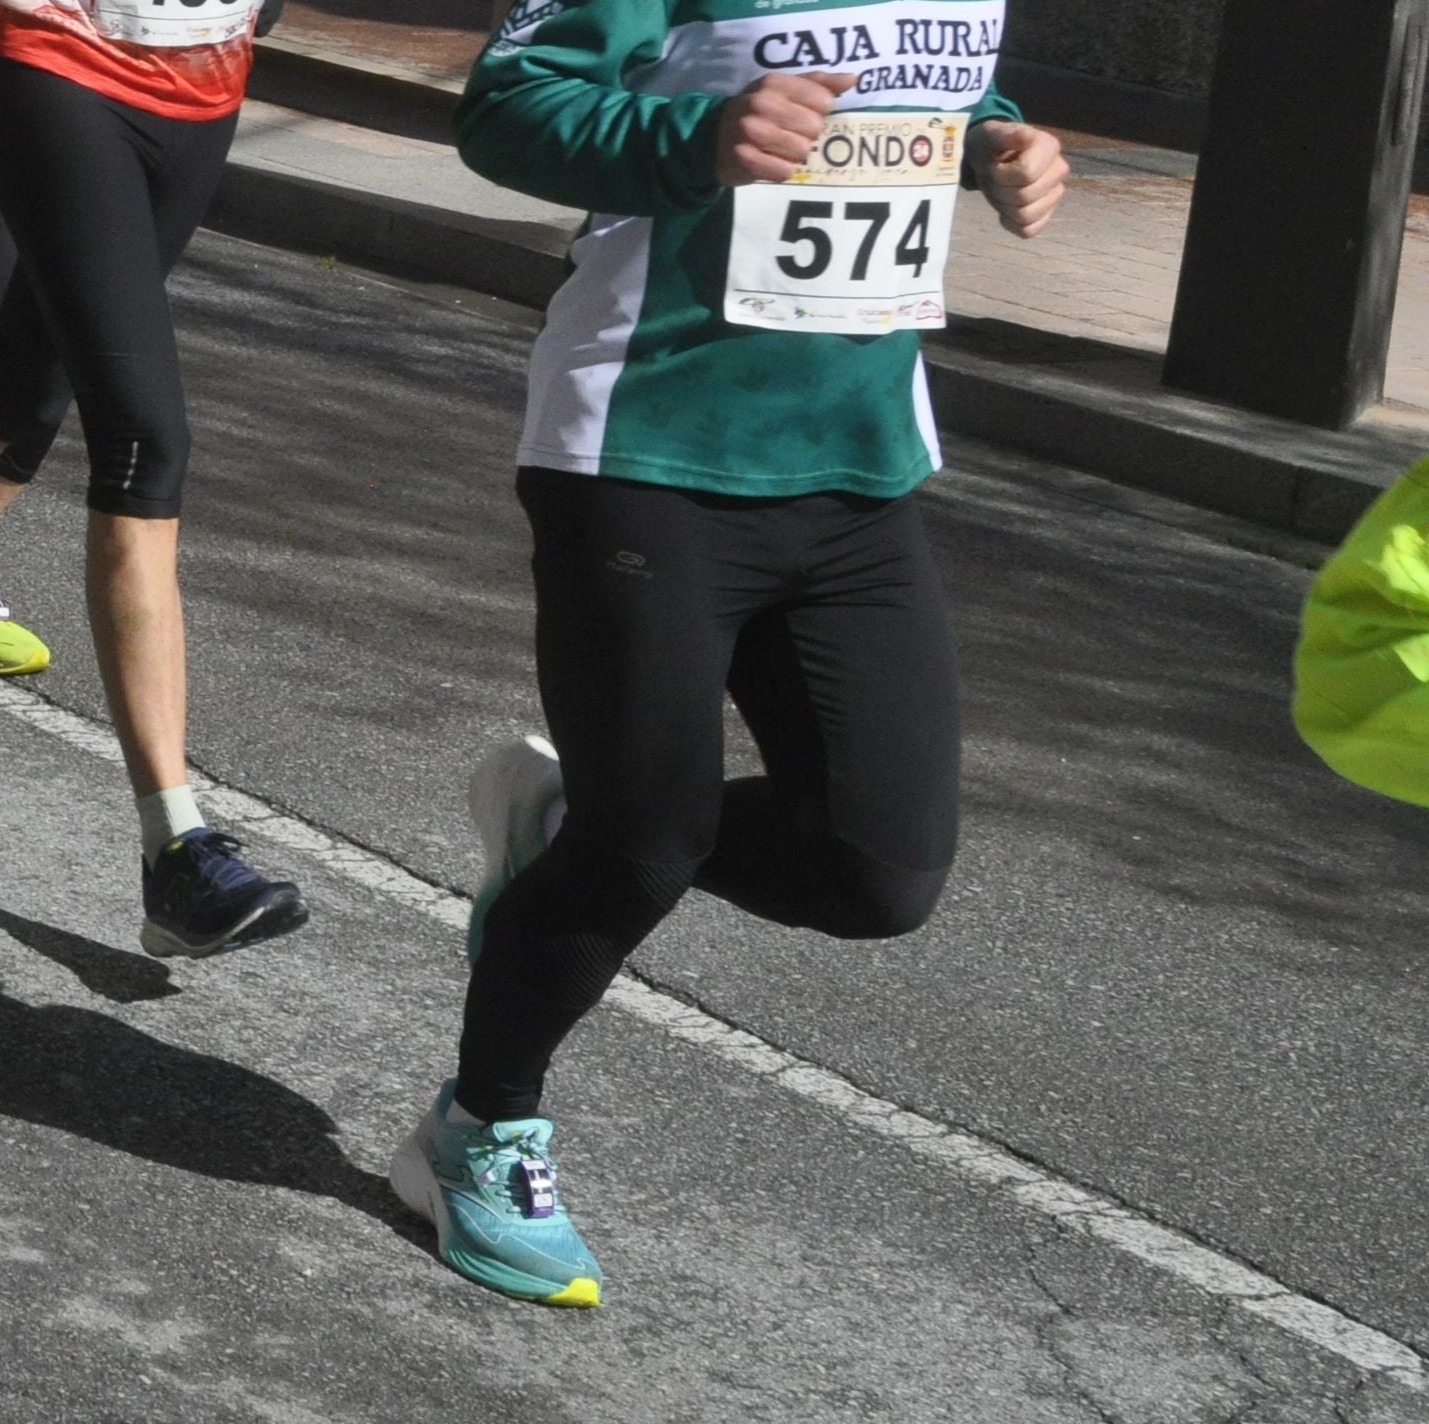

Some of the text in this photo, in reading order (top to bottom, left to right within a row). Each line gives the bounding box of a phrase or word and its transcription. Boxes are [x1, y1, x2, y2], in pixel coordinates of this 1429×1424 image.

[753, 24, 879, 69] CAJA
[855, 63, 983, 94] GRANADA
[860, 123, 912, 136] PREMIO
[801, 134, 933, 167] ONDO
[775, 198, 932, 281] 574
